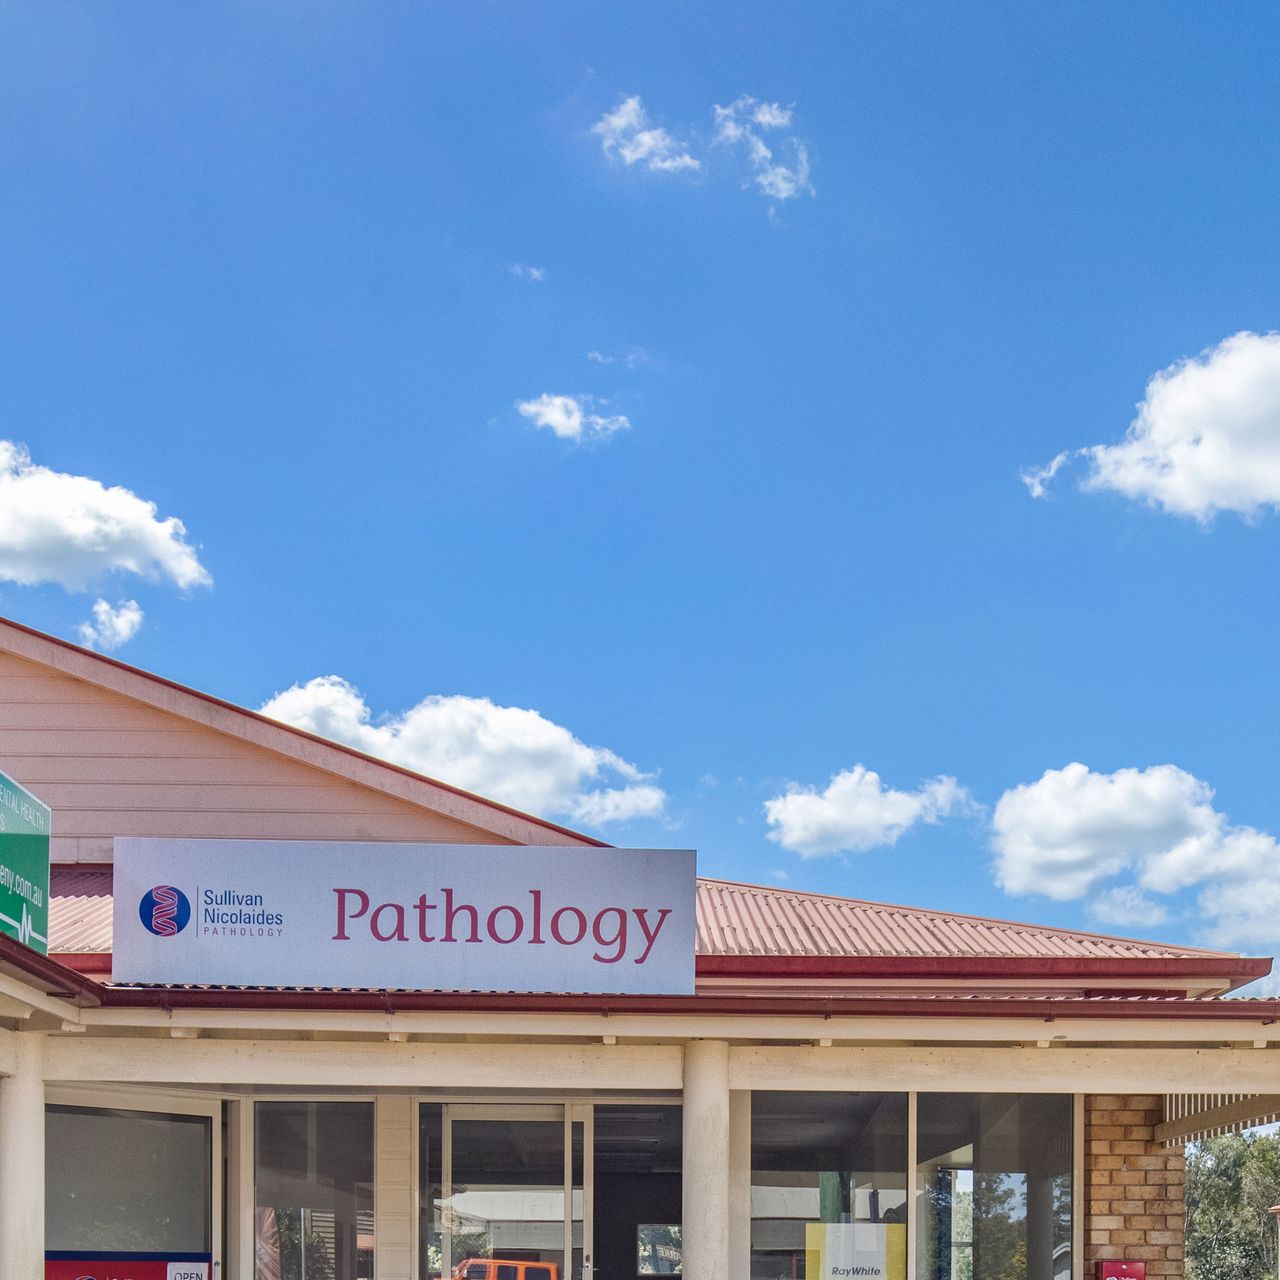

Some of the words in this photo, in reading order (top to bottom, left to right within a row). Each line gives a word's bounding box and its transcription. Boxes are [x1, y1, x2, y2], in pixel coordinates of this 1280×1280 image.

[20, 802, 44, 832] HEALTH
[204, 889, 263, 906] Sullivan
[204, 908, 283, 925] Nicolaides
[204, 926, 282, 937] PATHOLOGY
[332, 887, 672, 964] Pathology
